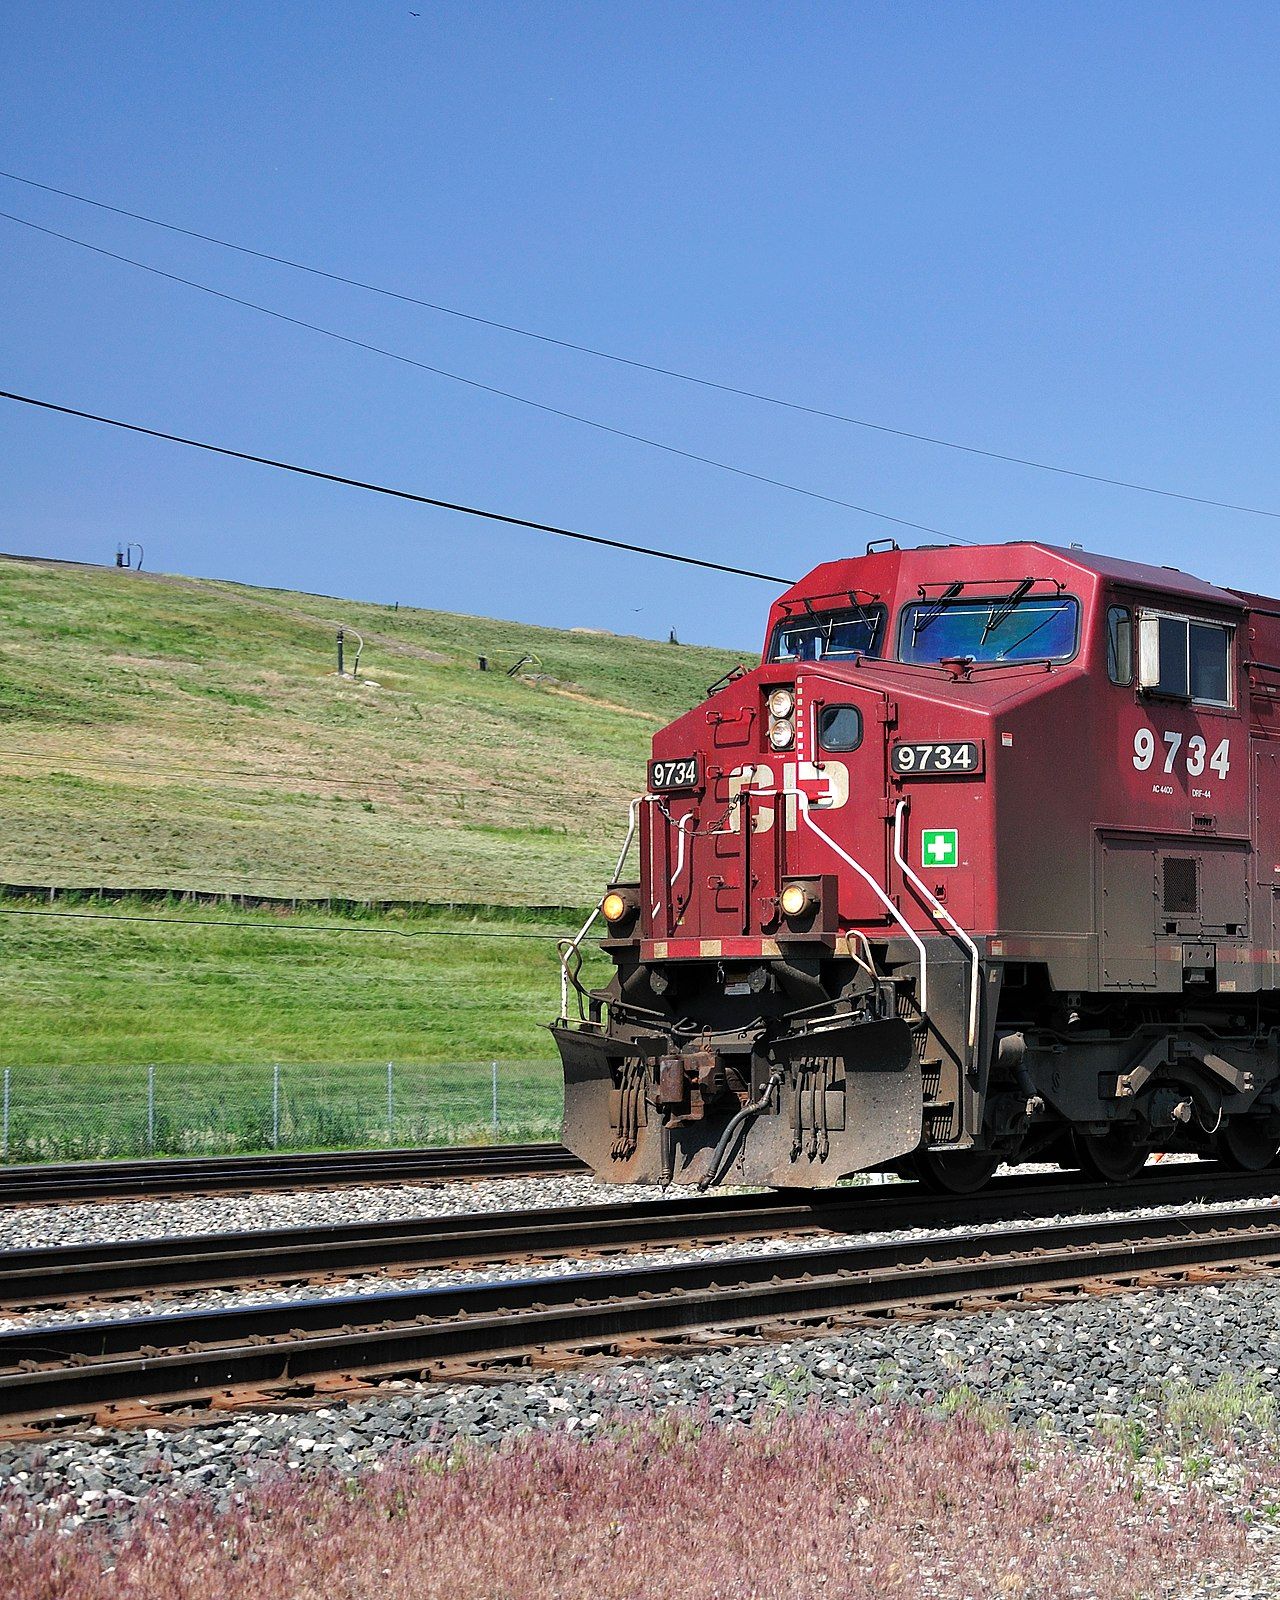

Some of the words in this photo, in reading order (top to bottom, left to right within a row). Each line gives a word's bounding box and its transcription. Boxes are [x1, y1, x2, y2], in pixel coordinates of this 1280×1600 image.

[654, 760, 695, 786] 9734
[897, 743, 972, 771] 9734
[1132, 727, 1230, 780] 9734
[728, 760, 850, 835] CP
